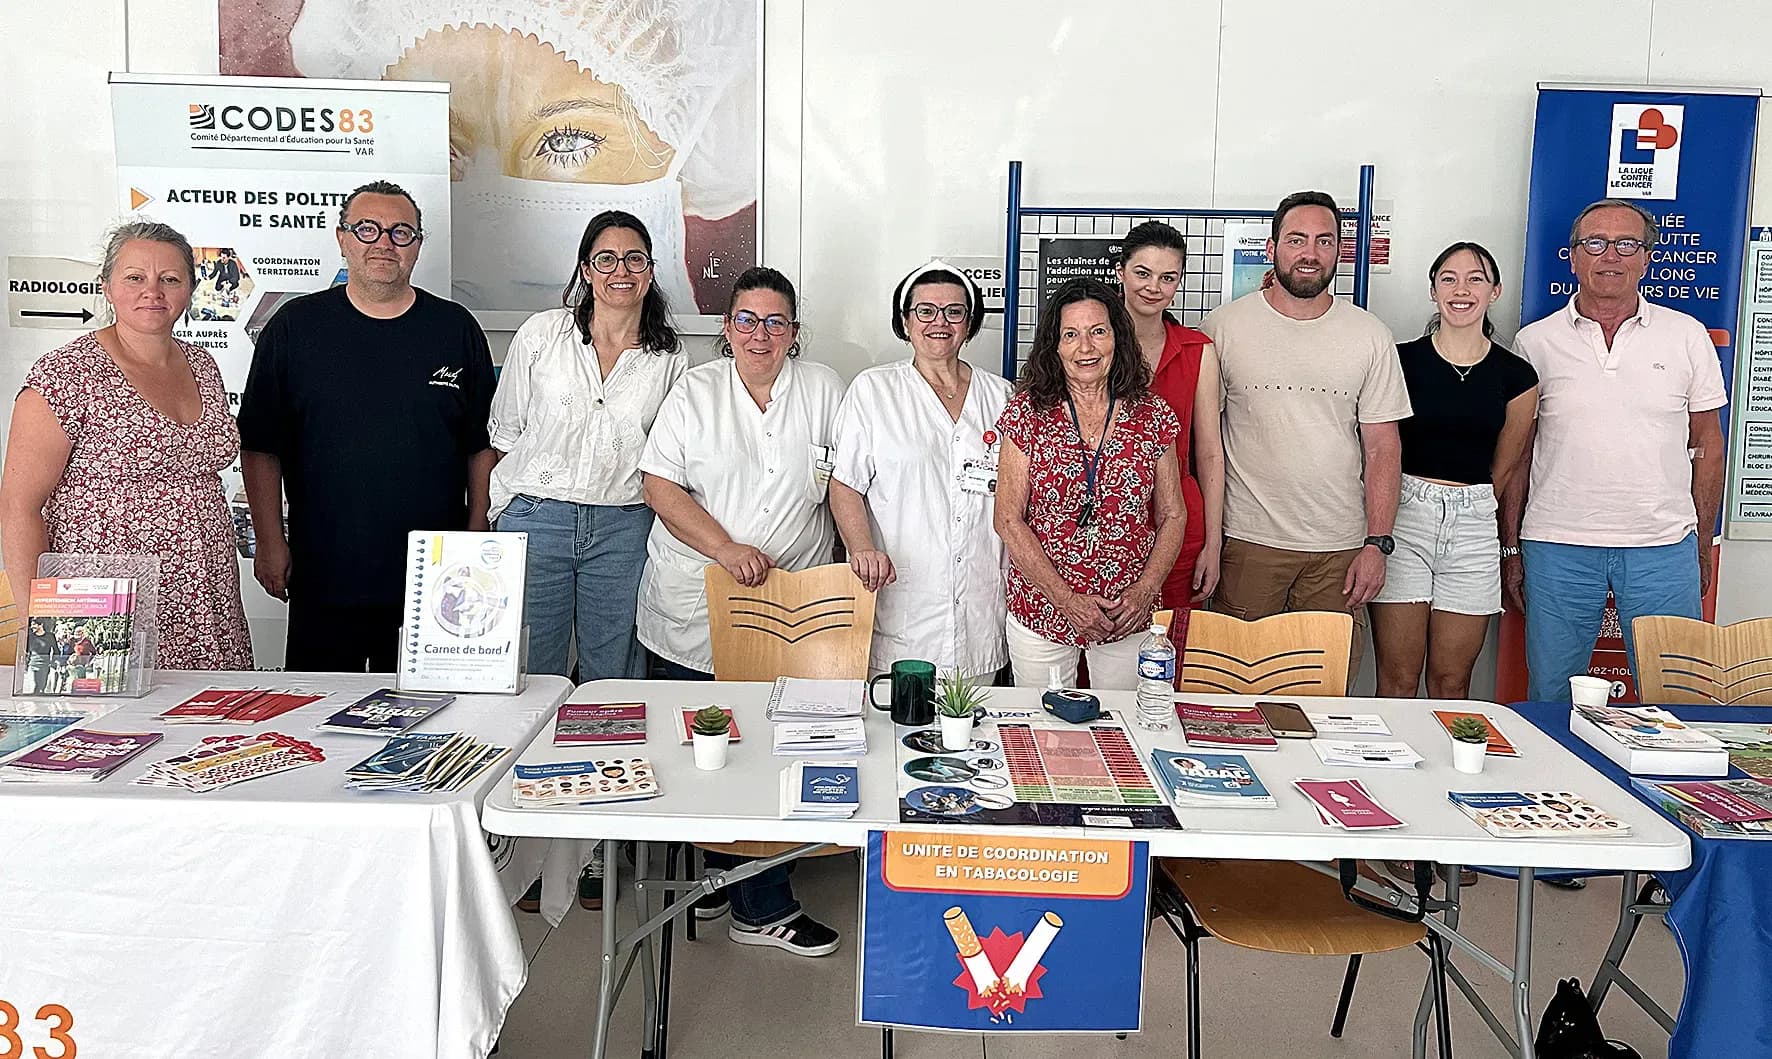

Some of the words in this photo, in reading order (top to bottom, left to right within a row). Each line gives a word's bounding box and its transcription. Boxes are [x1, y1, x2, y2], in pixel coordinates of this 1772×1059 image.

[221, 105, 374, 134] CODES83
[190, 133, 219, 141] Comité
[220, 134, 278, 145] Départemental
[279, 135, 324, 144] d'Éducation
[353, 137, 375, 145] Santé
[167, 189, 237, 204] ACTEUR
[244, 191, 279, 205] DES
[239, 213, 263, 227] DE
[269, 210, 327, 229] SANTÉ
[1654, 233, 1700, 246] UTTE
[252, 257, 321, 266] COORDINATION
[1046, 257, 1062, 265] Les
[1063, 257, 1097, 265] chaînes
[1098, 257, 1110, 265] de
[1650, 251, 1717, 264] CANCER
[257, 267, 320, 276] TERRITORIALE
[963, 269, 1002, 280] CCES
[1046, 267, 1092, 275] l'addiction
[1650, 268, 1696, 281] LONG
[9, 280, 103, 295] RADIOLOGIE
[1550, 282, 1575, 295] DU
[1668, 287, 1690, 299] DE
[1695, 287, 1720, 300] VIE
[195, 329, 228, 338] AUPRÈS
[424, 644, 460, 654] Carnet
[462, 645, 476, 654] de
[478, 645, 502, 655] bord
[1181, 767, 1252, 780] TABAC
[902, 843, 953, 858] UNITE
[956, 845, 979, 859] DE
[983, 847, 1109, 864] COORDINATION
[935, 865, 958, 879] EN
[963, 866, 1080, 883] TABACOLOGIE
